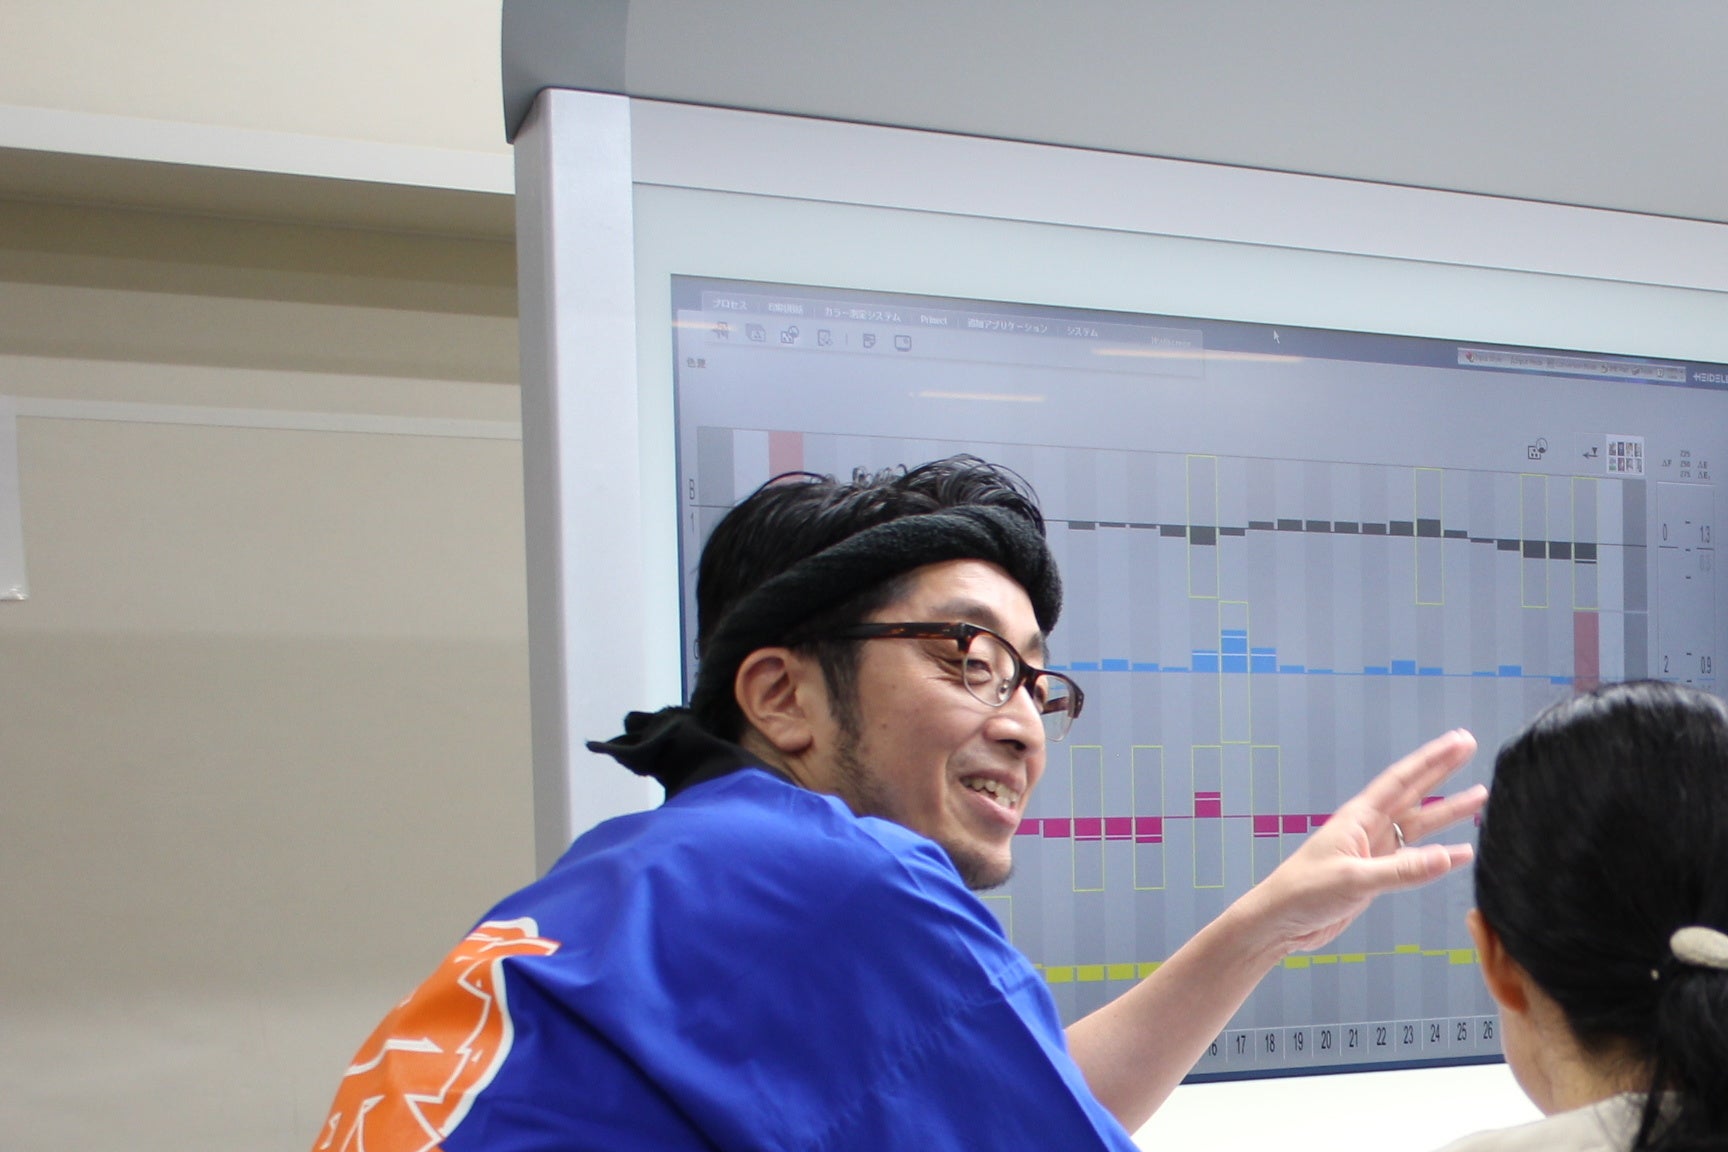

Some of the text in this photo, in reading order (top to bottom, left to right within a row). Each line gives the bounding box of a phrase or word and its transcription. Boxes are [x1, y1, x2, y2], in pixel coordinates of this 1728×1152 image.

[1236, 1034, 1246, 1054] 17
[1265, 1033, 1276, 1053] 18
[1294, 1031, 1304, 1051] 19
[1321, 1030, 1332, 1050] 20
[1349, 1028, 1359, 1048] 21
[1376, 1026, 1387, 1046] 22
[1403, 1025, 1414, 1044] 23
[1430, 1023, 1441, 1042] 24
[1457, 1022, 1468, 1041] 25
[1483, 1020, 1494, 1040] 26
